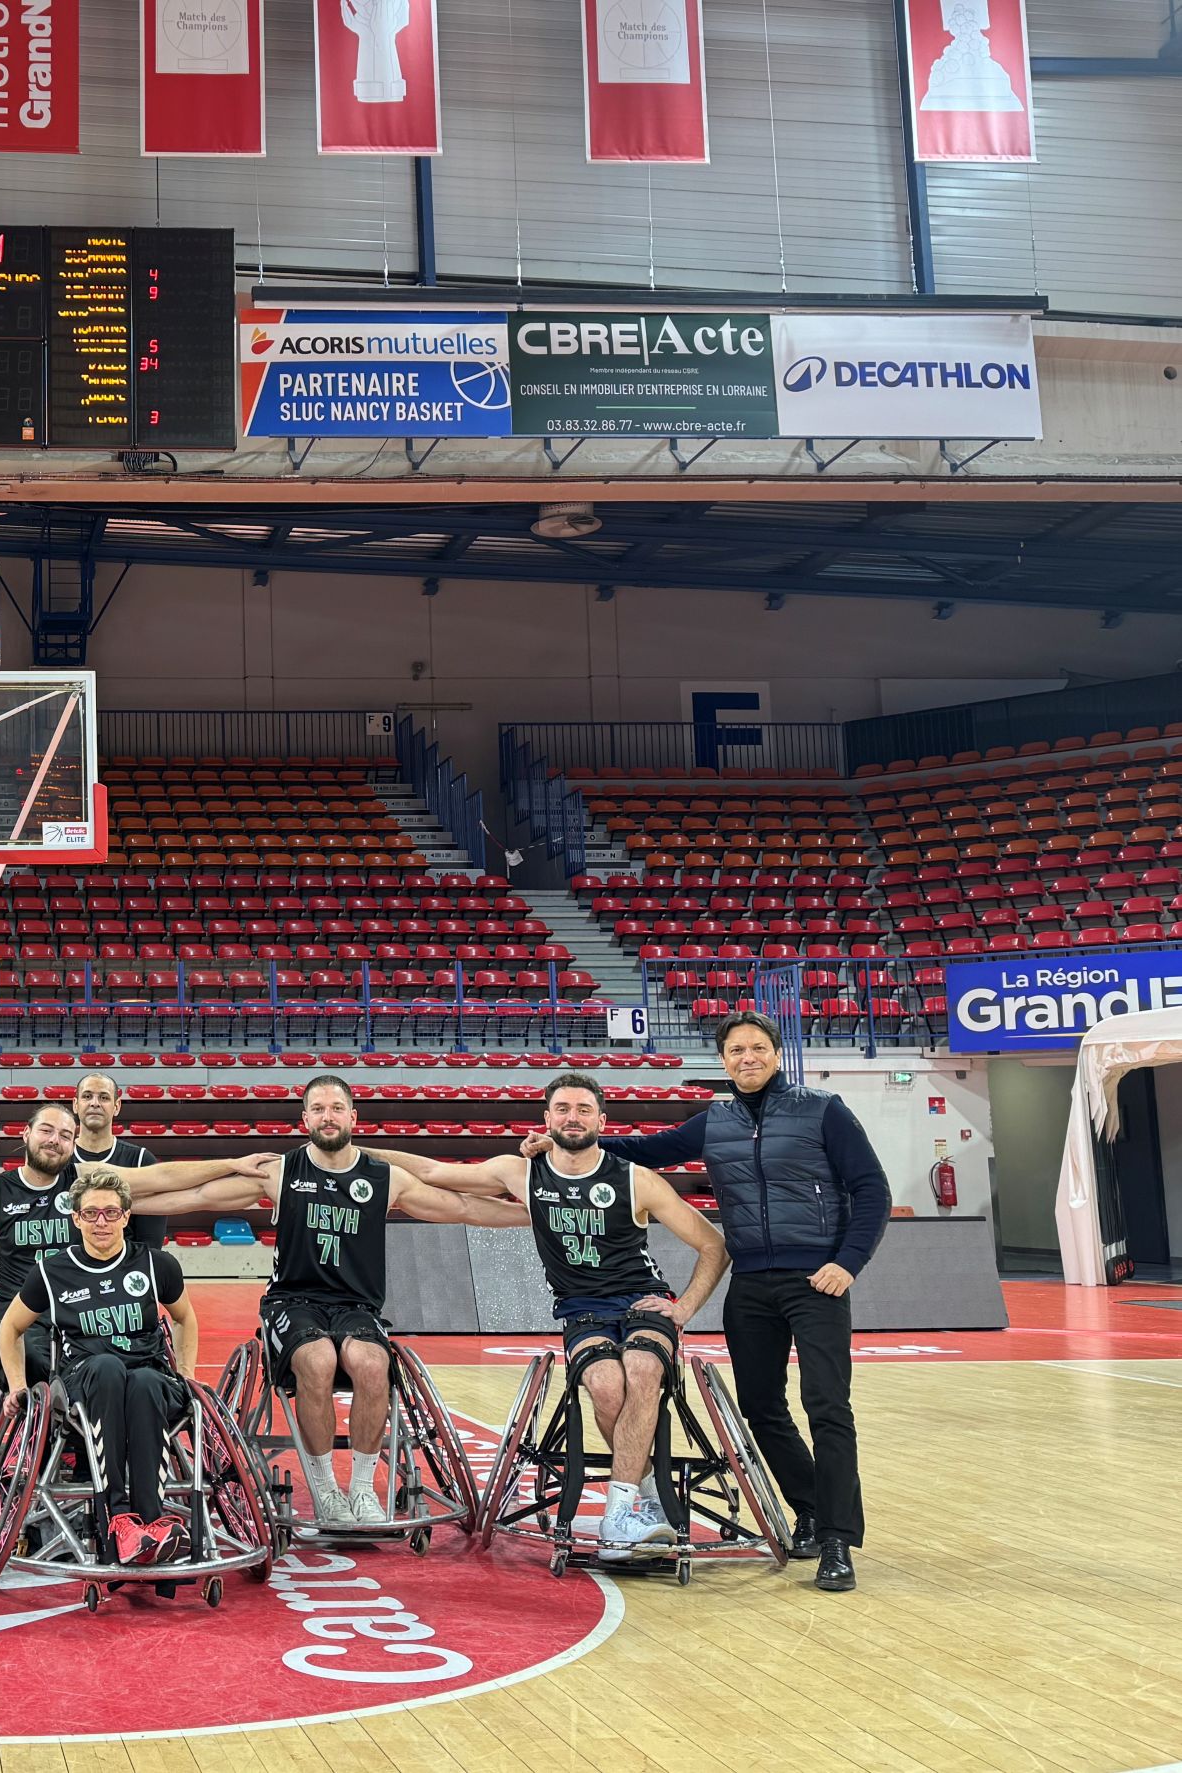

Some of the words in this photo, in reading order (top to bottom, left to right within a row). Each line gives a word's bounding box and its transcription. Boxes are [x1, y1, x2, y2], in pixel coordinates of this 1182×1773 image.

[177, 21, 228, 32] Champions
[179, 12, 206, 21] Match
[211, 13, 226, 22] des
[620, 22, 647, 31] Match
[651, 23, 666, 31] des
[618, 31, 668, 41] Champions
[280, 336, 364, 354] ACORIS
[368, 332, 497, 355] mutuelles
[650, 315, 765, 356] Acte
[280, 372, 419, 397] PARTENAIRE
[834, 361, 1030, 390] DECATHLON
[521, 384, 561, 395] CONSEIL
[564, 384, 577, 395] EN
[580, 384, 634, 395] IMMOBILIER
[637, 384, 703, 396] D'ENTREPRISE
[706, 385, 719, 395] EN
[722, 385, 768, 397] LORRAINE
[280, 402, 325, 421] SLUC
[331, 402, 389, 421] NANCY
[396, 402, 463, 421] BASKET
[547, 419, 633, 431] 03.83.32.86.77
[643, 421, 746, 432] www.cbre-acte.fr
[369, 715, 374, 724] F
[383, 716, 391, 732] 9
[691, 692, 762, 768] F
[1002, 972, 1028, 988] La
[1036, 967, 1118, 988] Région
[610, 1009, 619, 1020] F
[632, 1009, 644, 1034] 6
[307, 1203, 359, 1234] USVH
[549, 1207, 605, 1235] USVH
[15, 1218, 69, 1245] USVH
[318, 1234, 340, 1266] 71
[562, 1236, 600, 1267] 34
[79, 1303, 143, 1336] USVH
